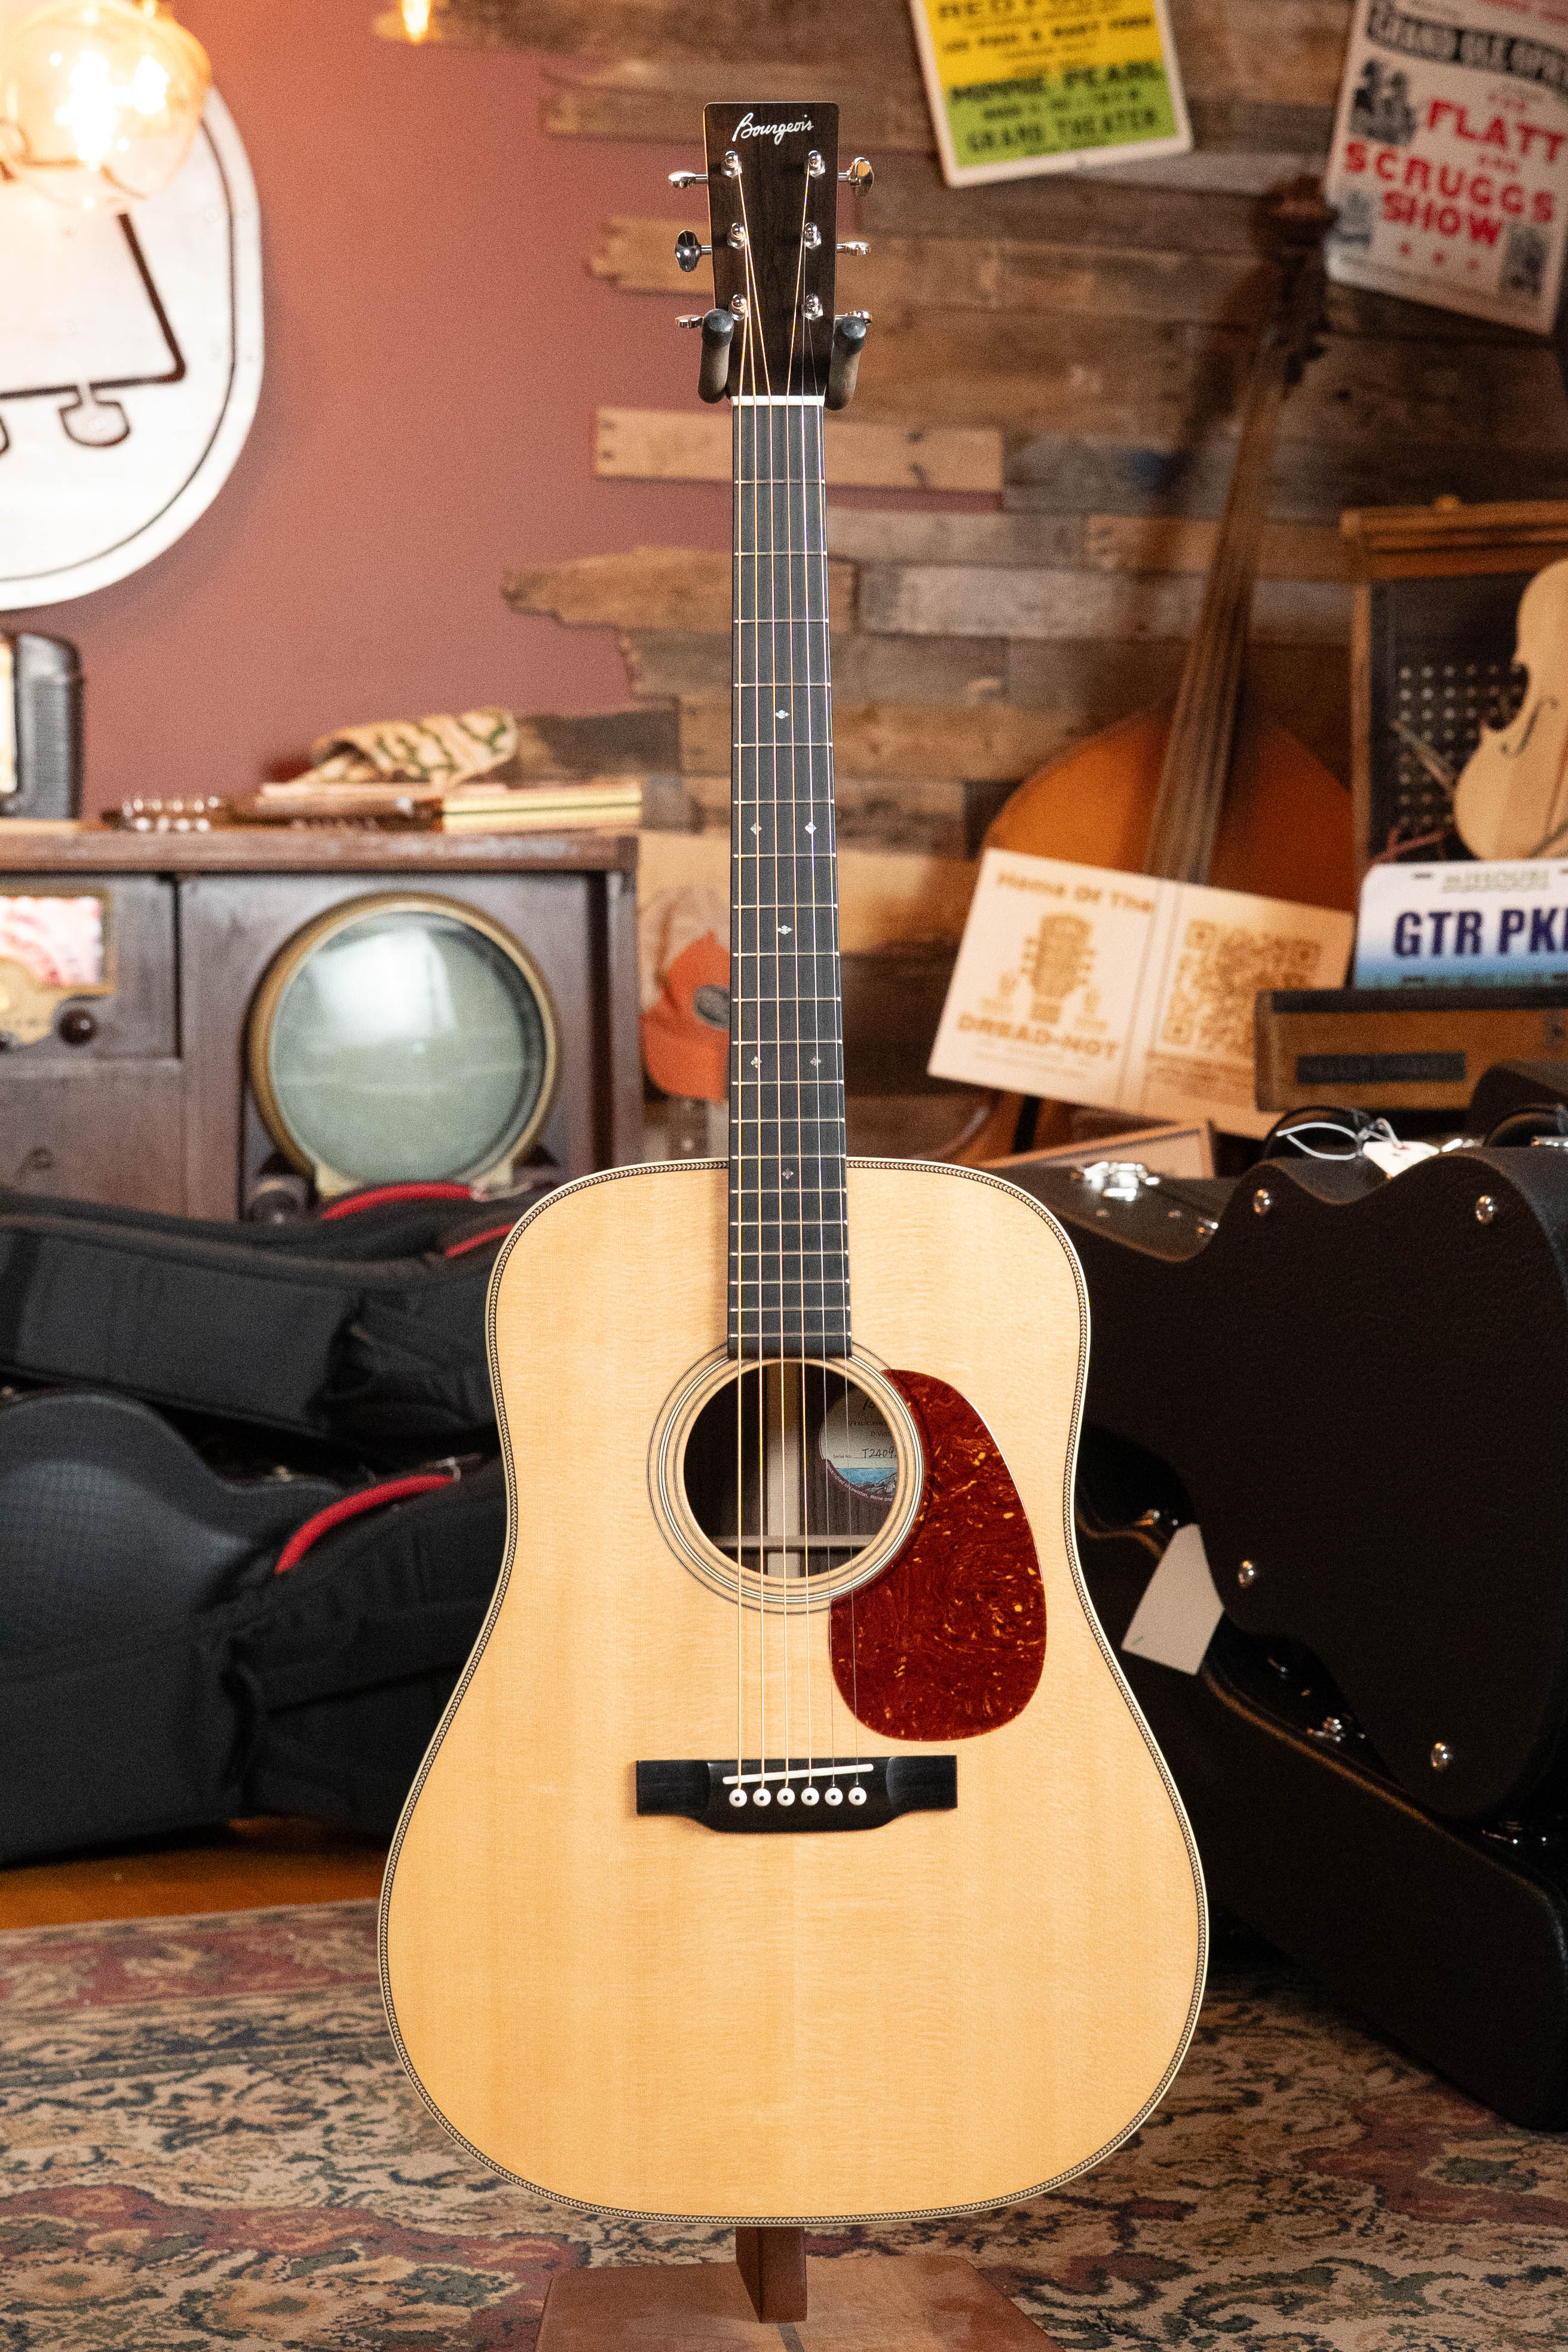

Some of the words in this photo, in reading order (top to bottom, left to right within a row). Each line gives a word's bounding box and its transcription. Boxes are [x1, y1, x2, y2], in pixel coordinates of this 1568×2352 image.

[731, 112, 814, 145] Bourgeois
[1426, 97, 1567, 163] FLATT
[1345, 142, 1554, 223] SCRUGGS
[1382, 190, 1503, 248] SHOW
[996, 871, 1067, 898] Home
[1073, 883, 1102, 904] Of
[1110, 891, 1155, 914] The
[1393, 910, 1483, 957] GTR
[956, 1012, 1120, 1060] DREAD-NOT
[861, 1446, 896, 1459] T2409
